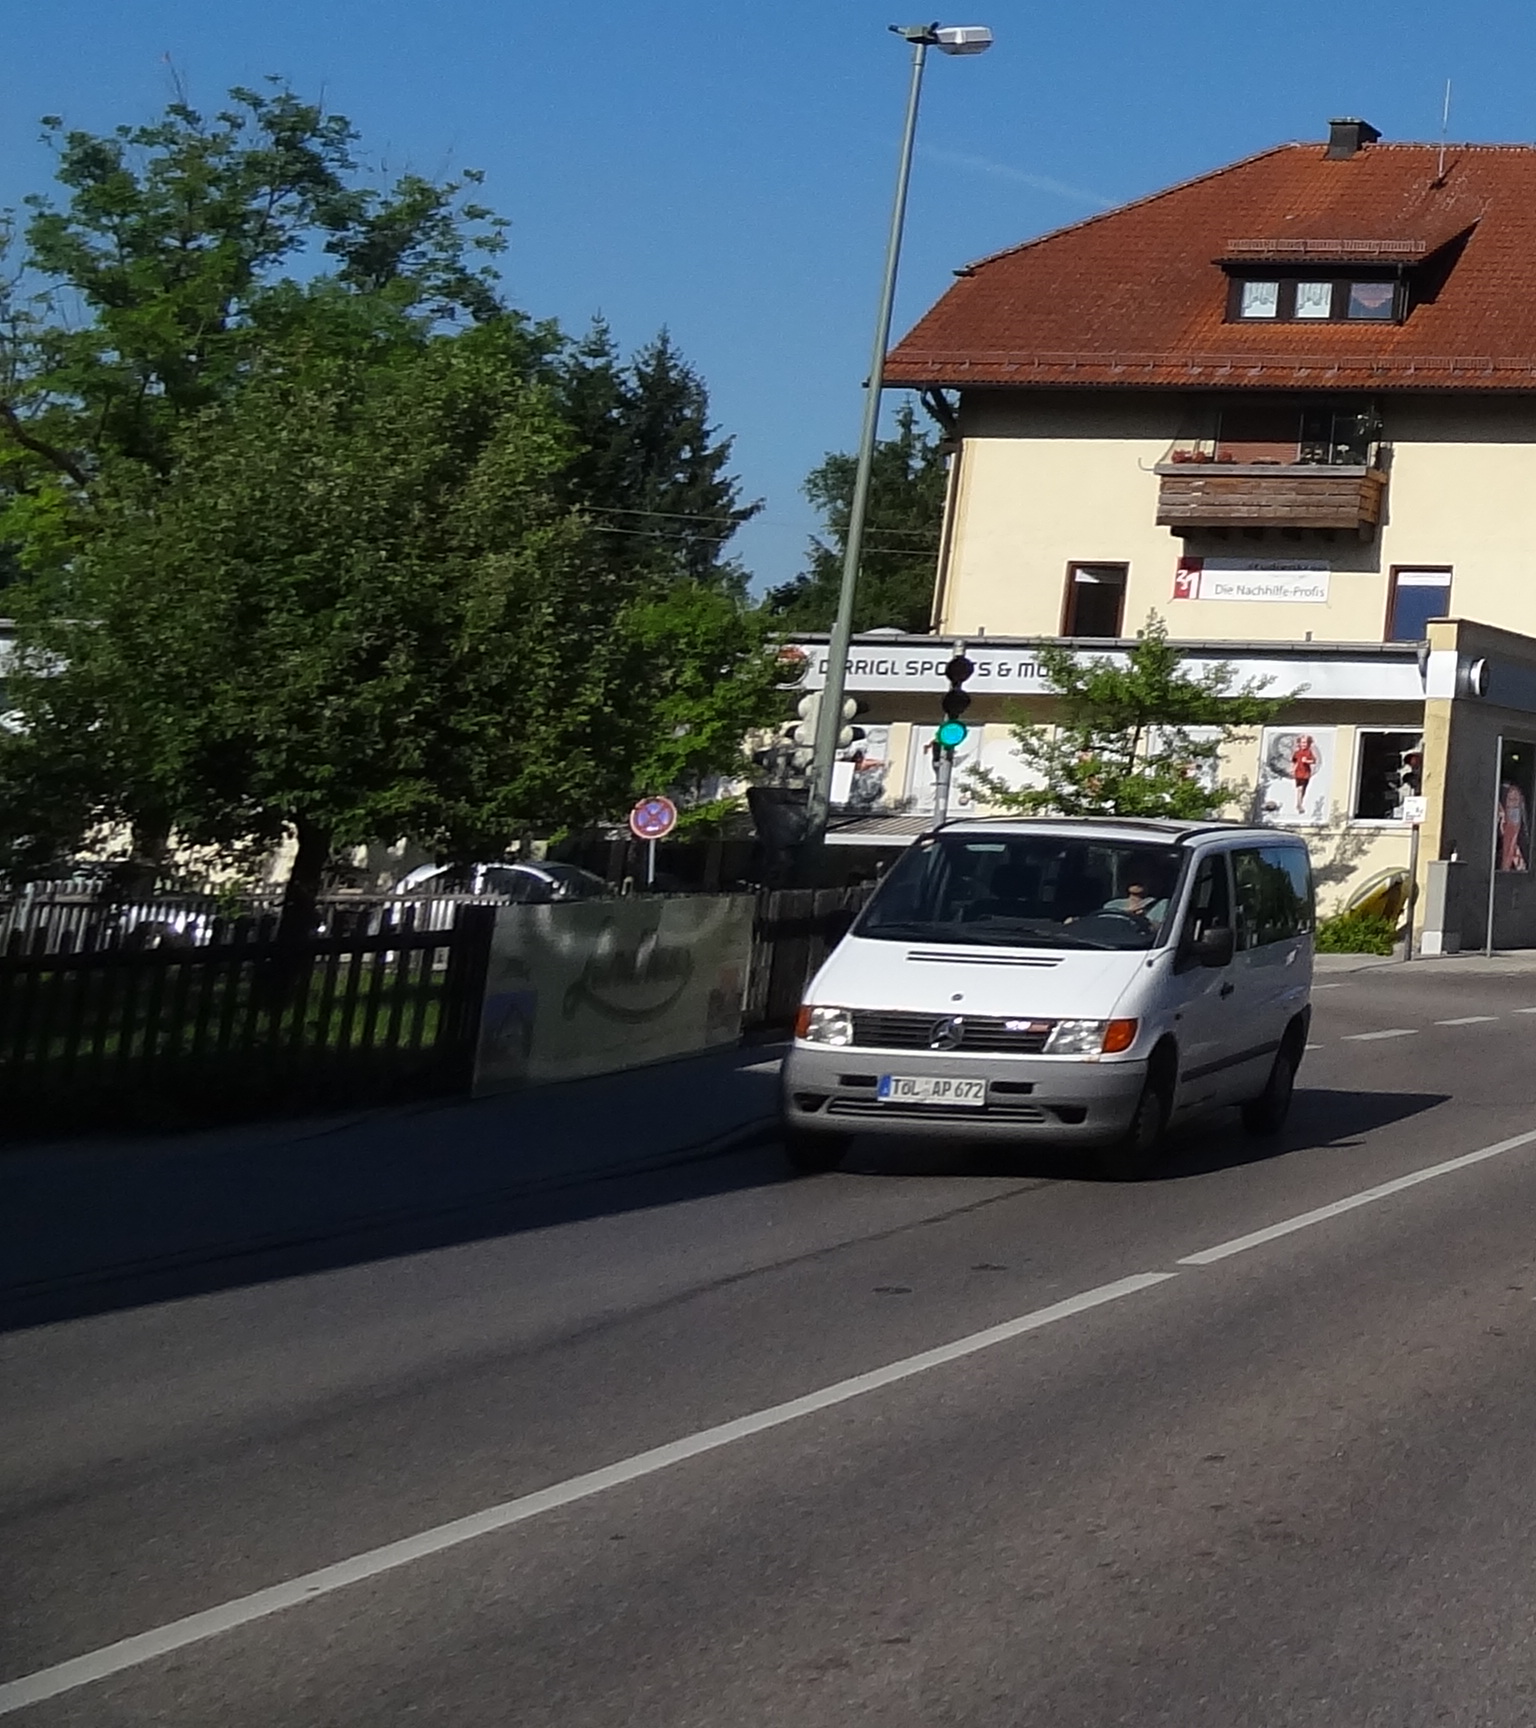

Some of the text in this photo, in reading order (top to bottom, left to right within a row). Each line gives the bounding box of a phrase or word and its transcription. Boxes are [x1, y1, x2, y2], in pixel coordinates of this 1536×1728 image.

[1215, 583, 1325, 599] Die Nachhilfe-Profis
[818, 658, 1050, 678] DRRIGL SPOS & MO
[931, 1080, 953, 1097] AP
[954, 1081, 984, 1099] 672
